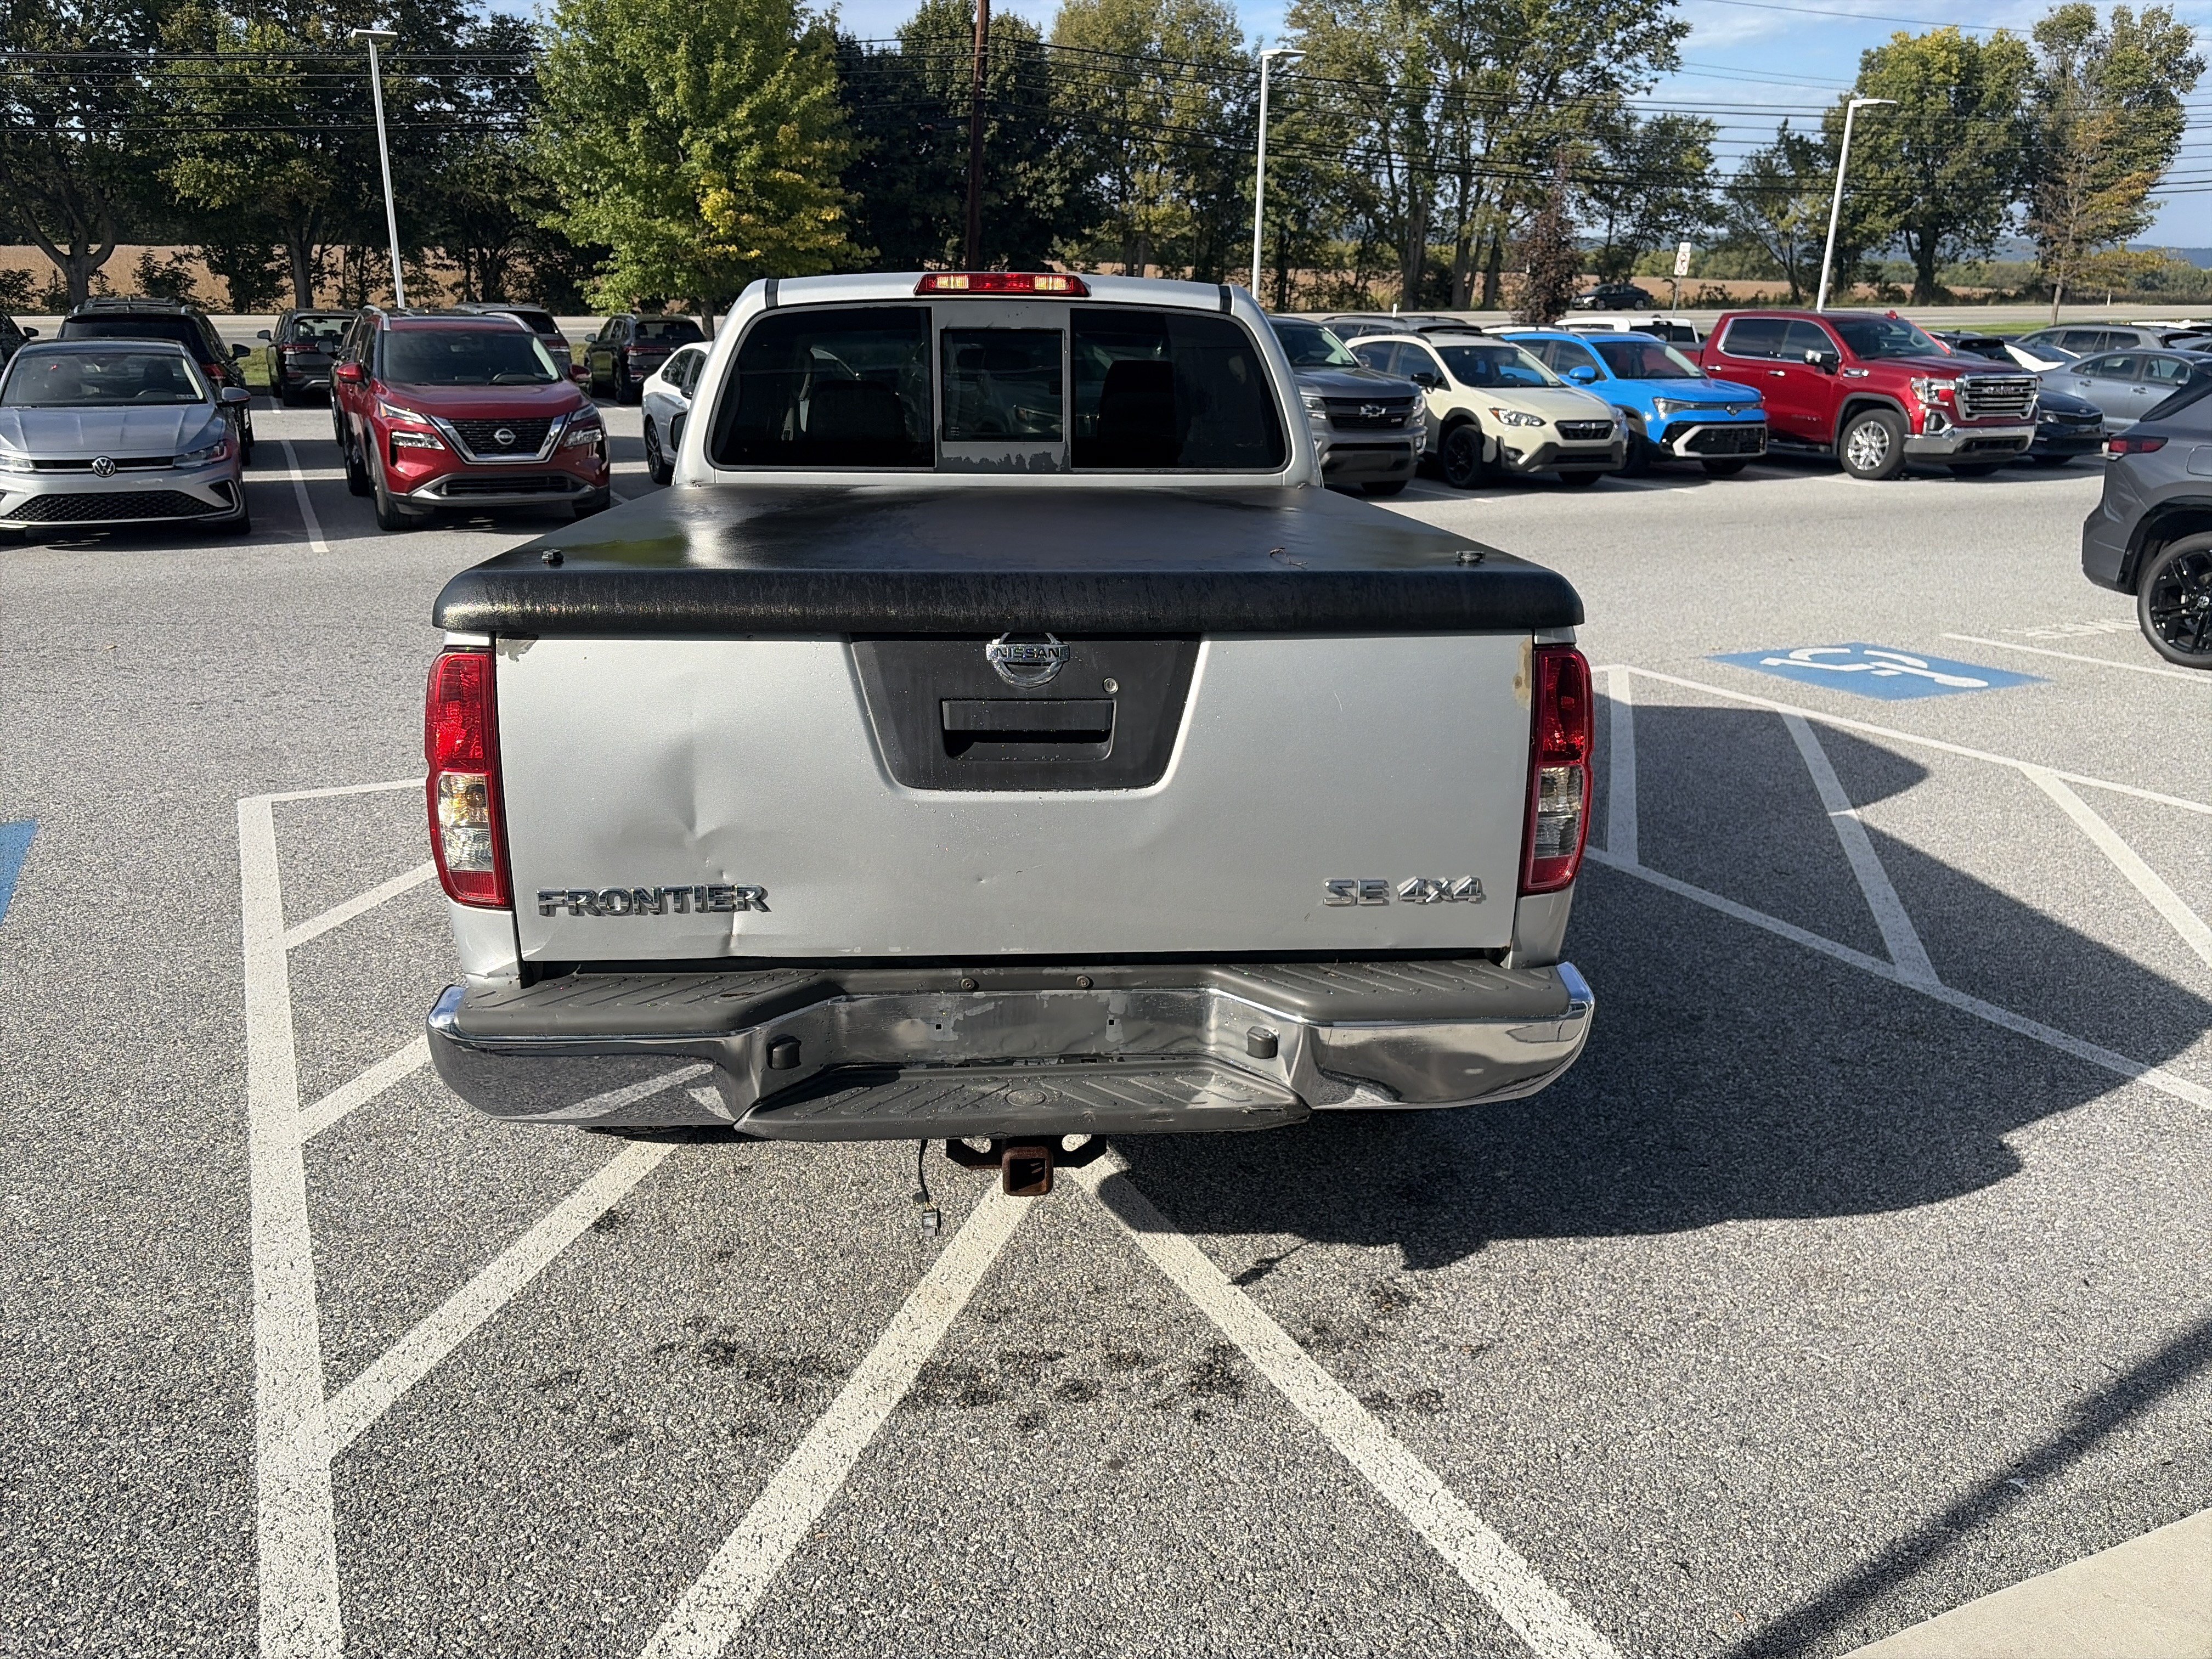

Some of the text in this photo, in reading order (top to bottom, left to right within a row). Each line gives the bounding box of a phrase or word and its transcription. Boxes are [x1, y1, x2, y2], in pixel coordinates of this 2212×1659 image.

[996, 647, 1060, 660] NISSAN
[535, 883, 771, 916] FRONTIER
[1323, 879, 1388, 905] SE
